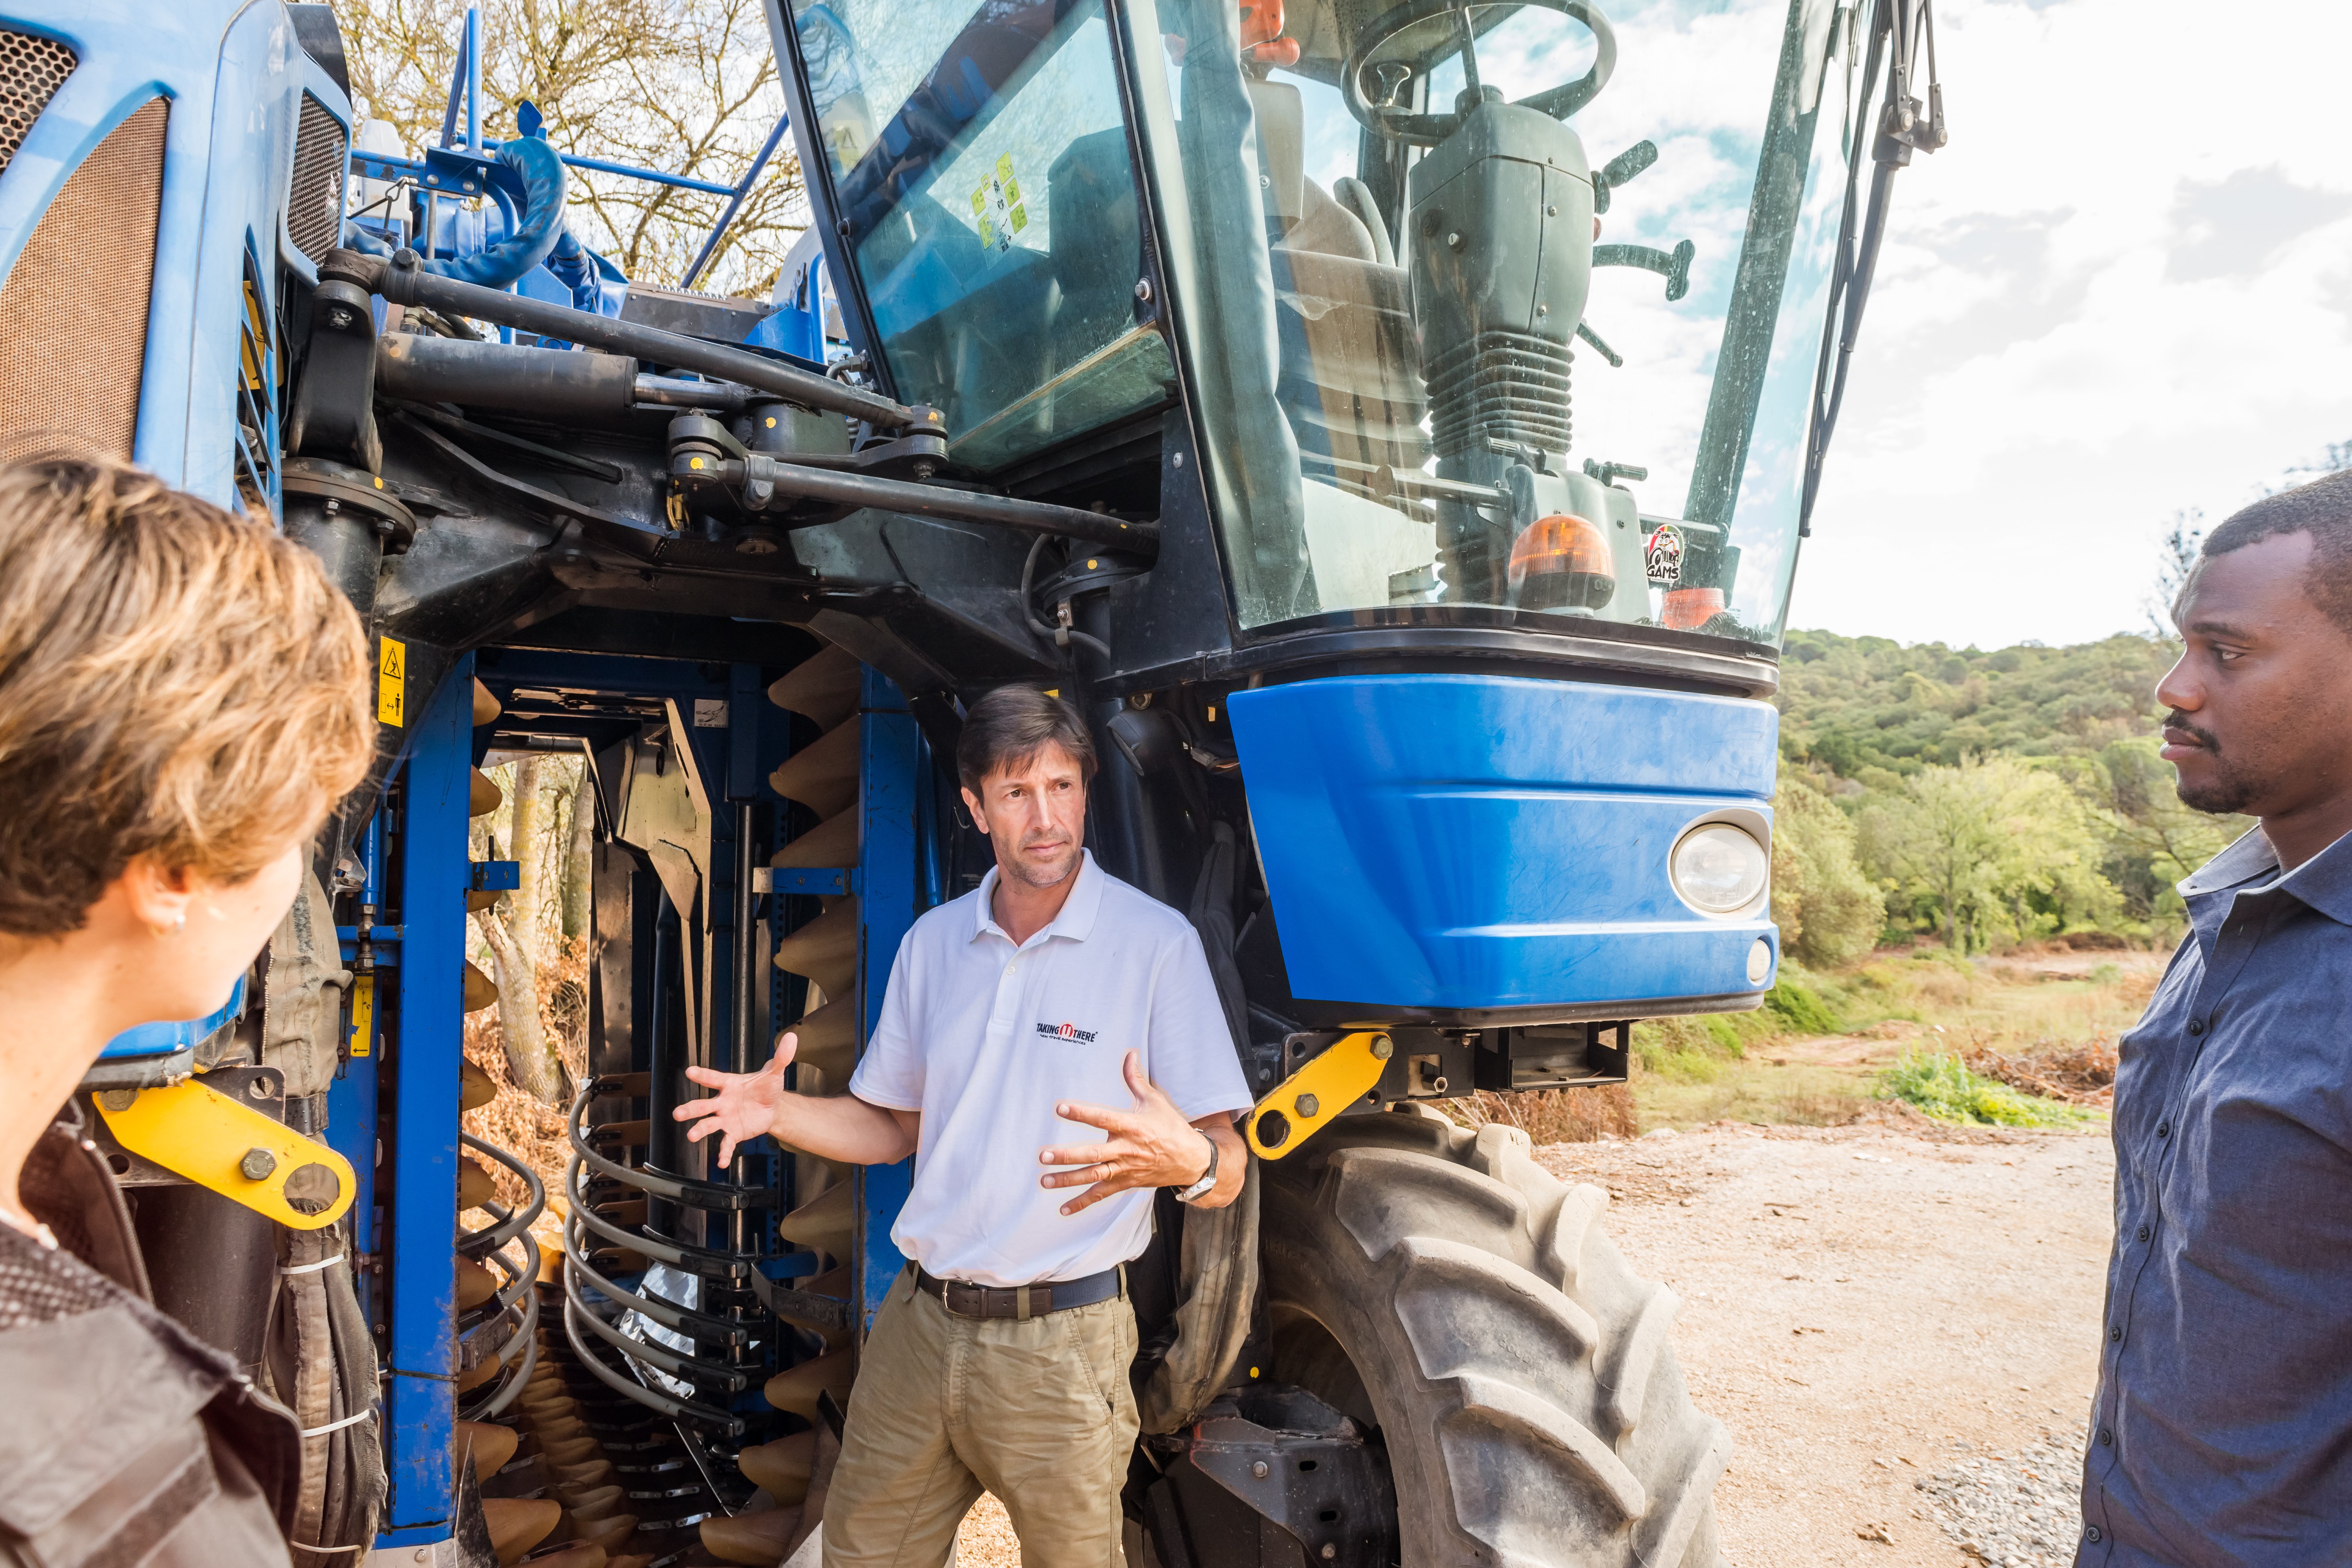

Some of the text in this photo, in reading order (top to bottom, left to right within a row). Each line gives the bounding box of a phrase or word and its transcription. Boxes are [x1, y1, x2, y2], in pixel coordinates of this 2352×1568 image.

[1647, 565, 1679, 579] GAMS
[1037, 1023, 1059, 1034] TAKING
[1073, 1030, 1096, 1042] THERE
